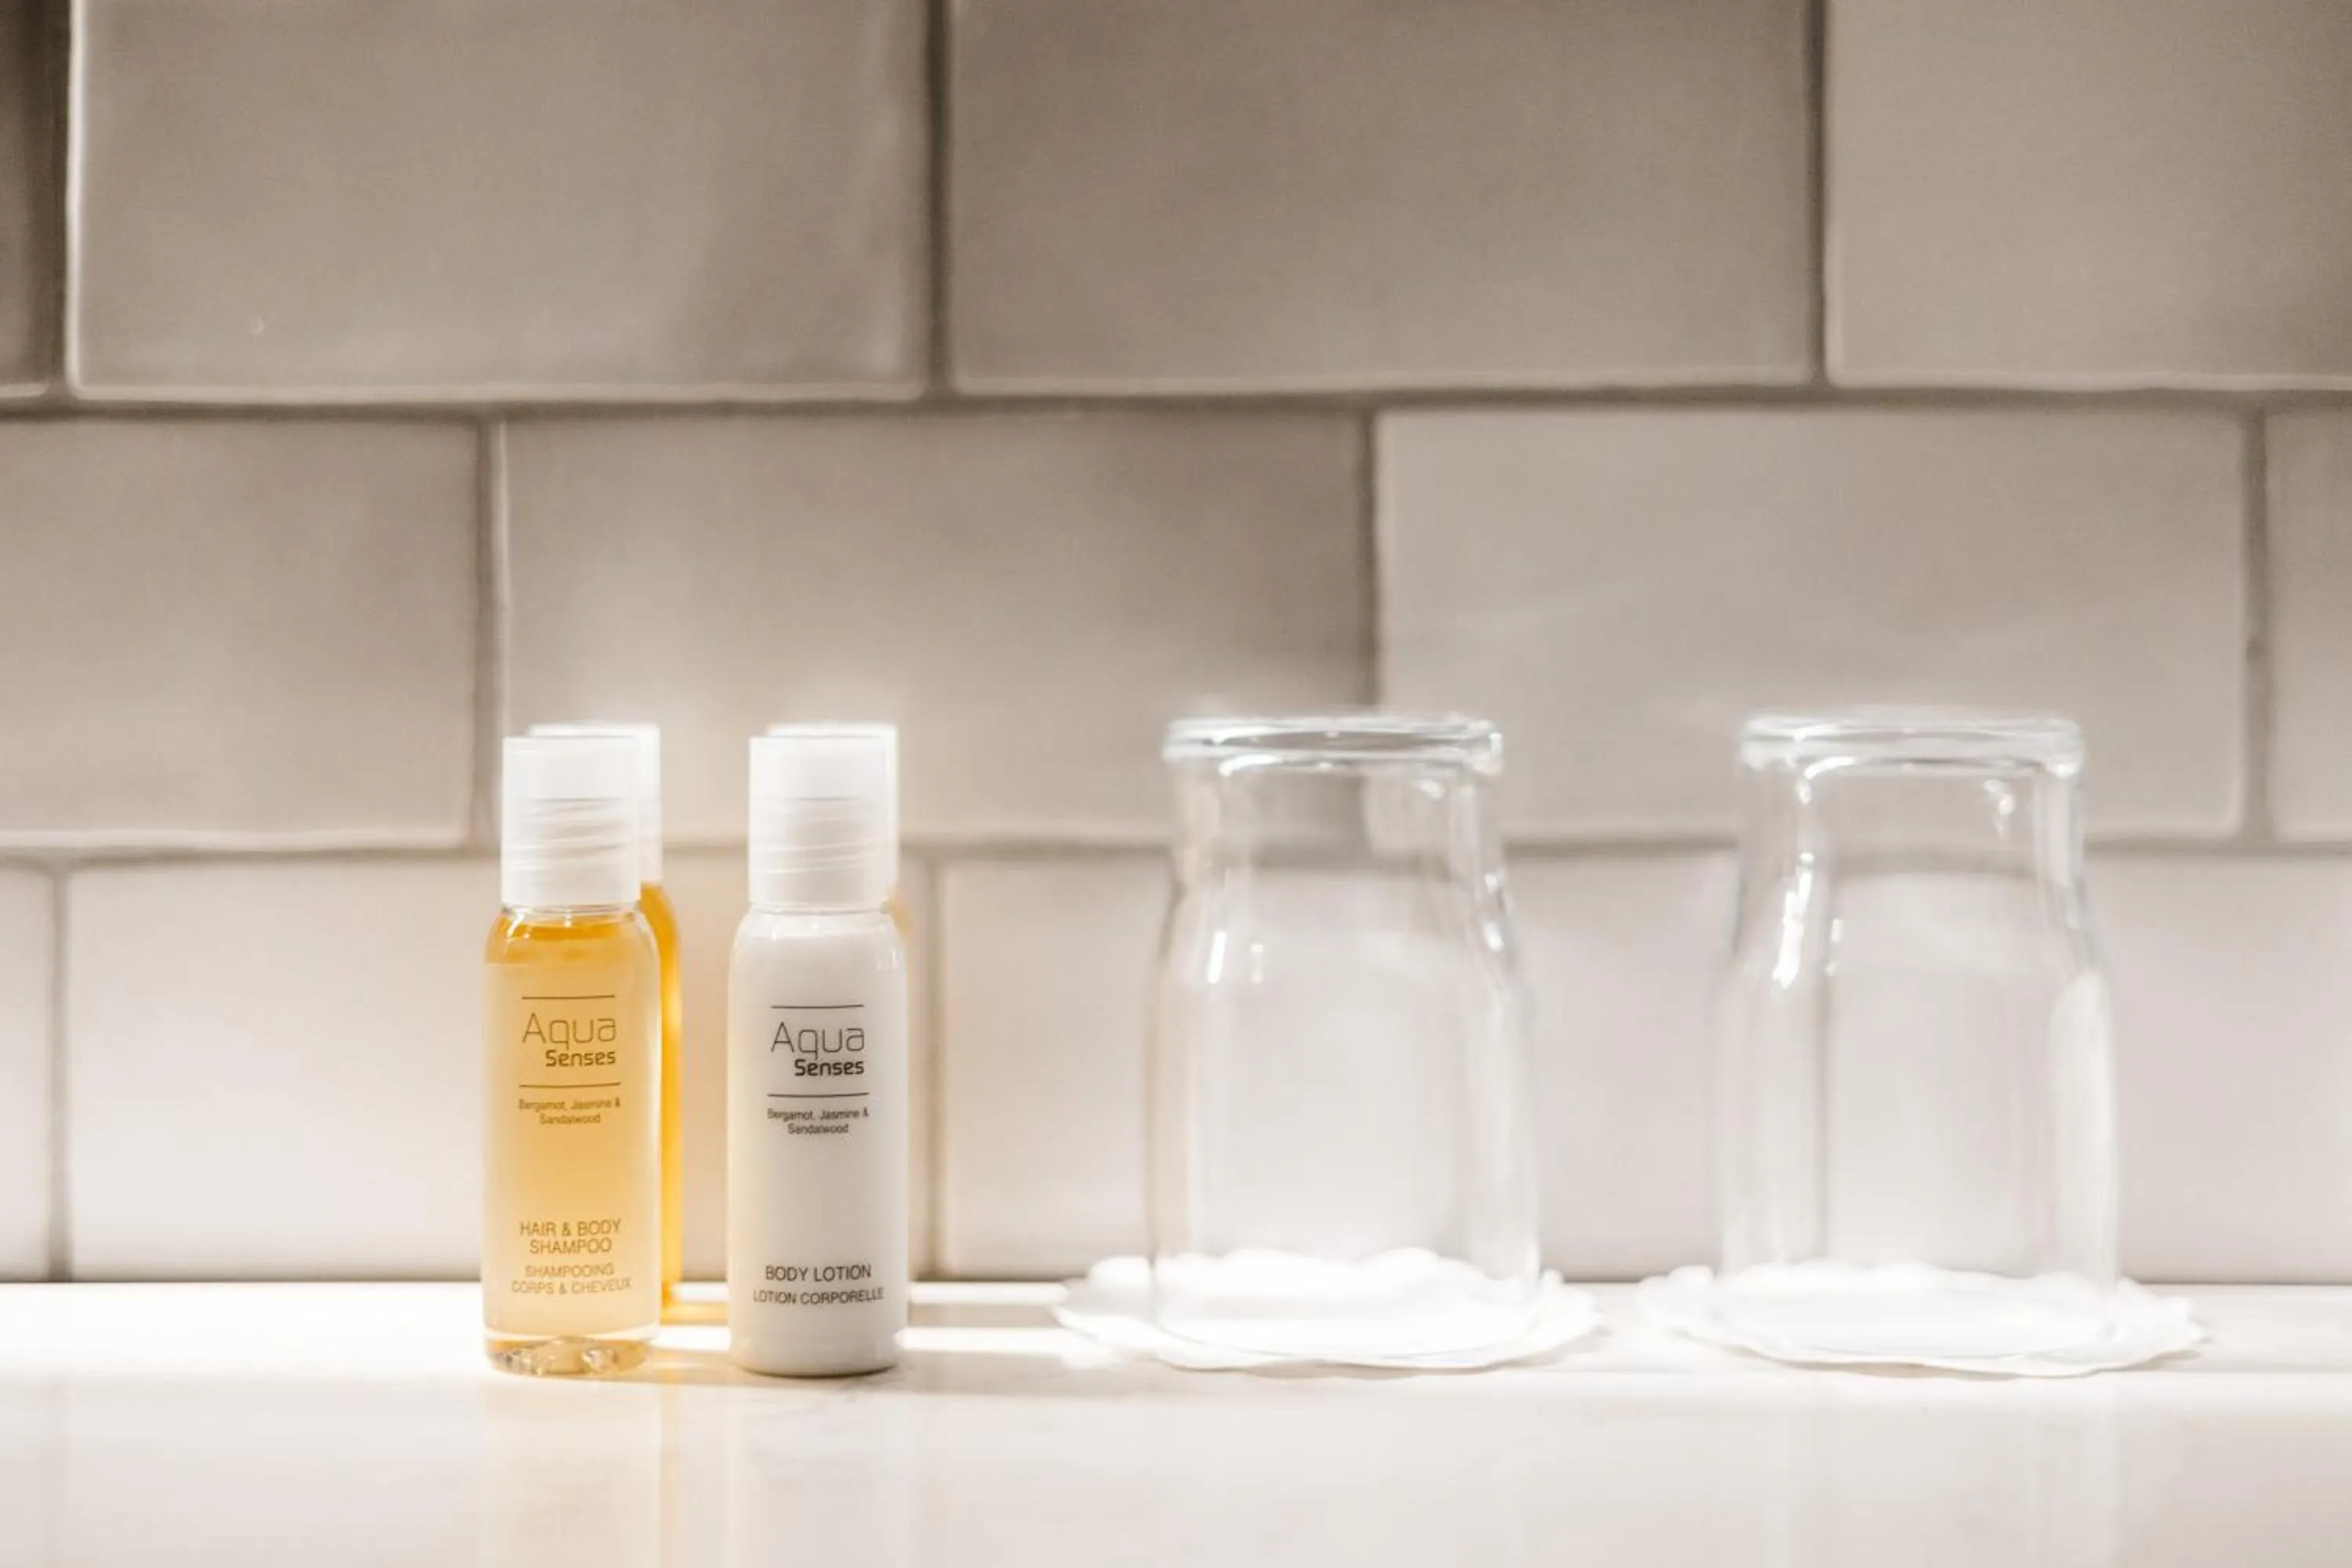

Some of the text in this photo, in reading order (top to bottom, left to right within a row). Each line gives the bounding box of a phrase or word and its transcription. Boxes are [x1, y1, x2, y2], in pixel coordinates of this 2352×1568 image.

[522, 1012, 616, 1051] Aqua
[771, 1021, 865, 1059] Aqua
[545, 1049, 616, 1067] Senses
[794, 1058, 865, 1076] Senses
[571, 1099, 612, 1110] Jasmine
[615, 1097, 621, 1108] &
[539, 1113, 601, 1125] Sandalwood
[819, 1108, 860, 1120] Jasmine
[862, 1107, 869, 1117] &
[787, 1123, 849, 1134] Sandalwood
[520, 1218, 622, 1236] HAIR & BODY
[529, 1237, 612, 1254] SHAMPOO
[524, 1262, 615, 1278] SHAMPOOING
[765, 1263, 872, 1282] BODY LOTION
[511, 1278, 633, 1294] CORPS & CHEVEUX
[753, 1287, 884, 1305] LOTION CORPORELLE
